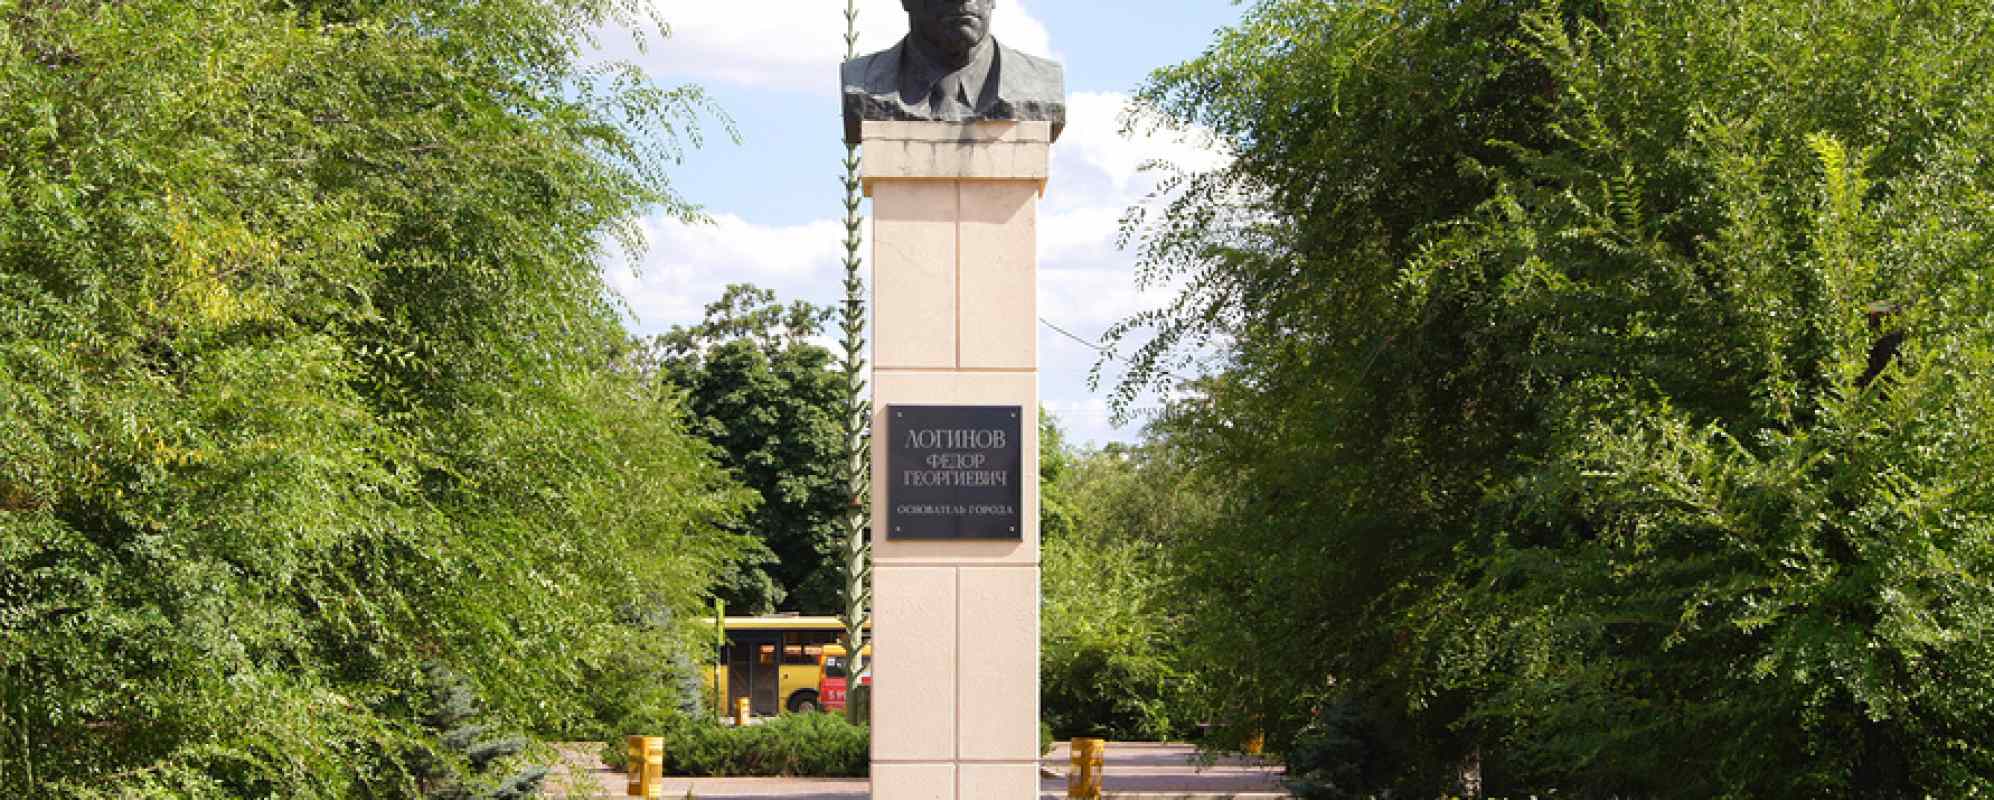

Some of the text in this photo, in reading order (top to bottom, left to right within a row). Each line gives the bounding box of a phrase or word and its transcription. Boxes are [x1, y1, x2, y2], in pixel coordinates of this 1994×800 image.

[904, 429, 1007, 449] ЛОГИНОВ
[926, 453, 986, 469] ФЕДОР
[903, 470, 1008, 486] ГЕОРГИЕВИЧ
[896, 504, 1014, 514] ОСНОВАТЕЛЬ ГОРОДА
